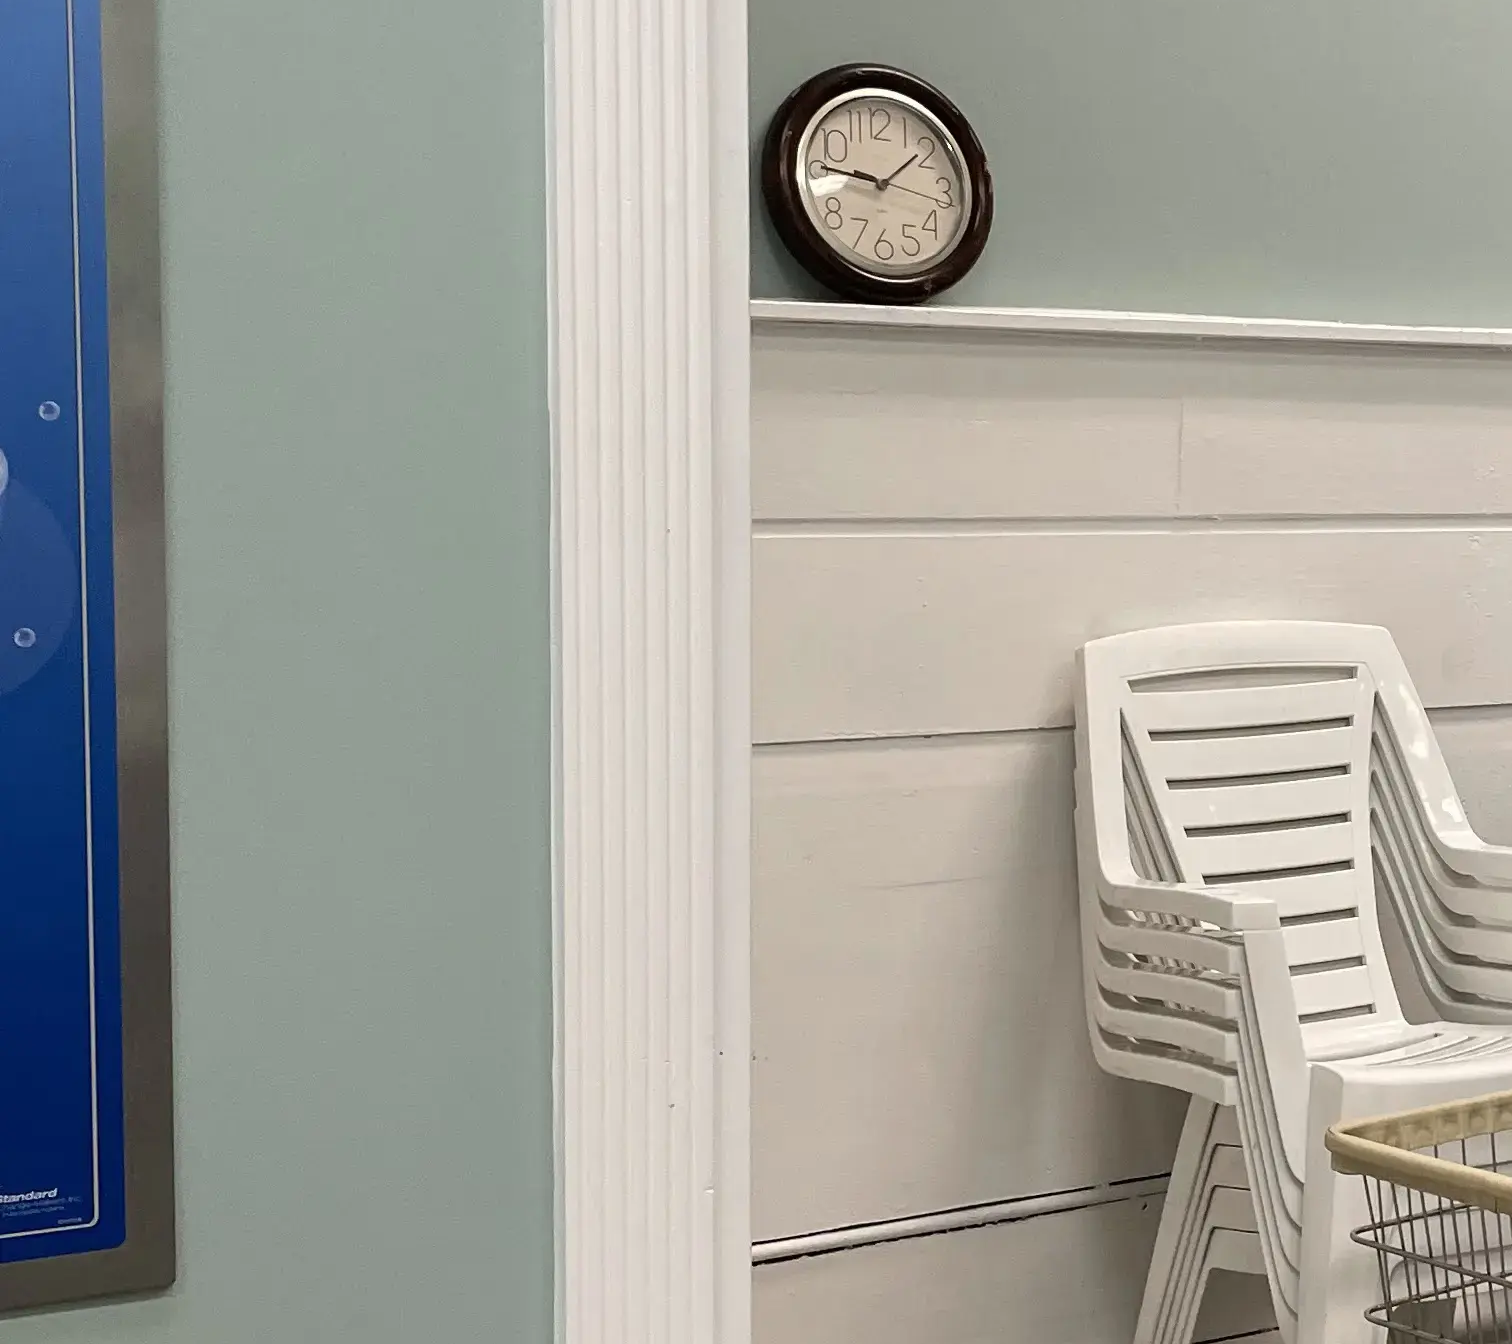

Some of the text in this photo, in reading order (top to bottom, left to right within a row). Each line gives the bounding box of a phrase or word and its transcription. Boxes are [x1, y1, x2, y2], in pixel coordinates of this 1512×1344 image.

[847, 110, 862, 144] 11
[868, 107, 891, 142] 12
[820, 127, 848, 163] 10
[917, 137, 936, 170] 2
[935, 177, 953, 209] 3
[824, 197, 843, 230] 8
[921, 209, 938, 241] 4
[850, 217, 869, 250] 7
[874, 228, 895, 261] 6
[901, 224, 921, 256] 5
